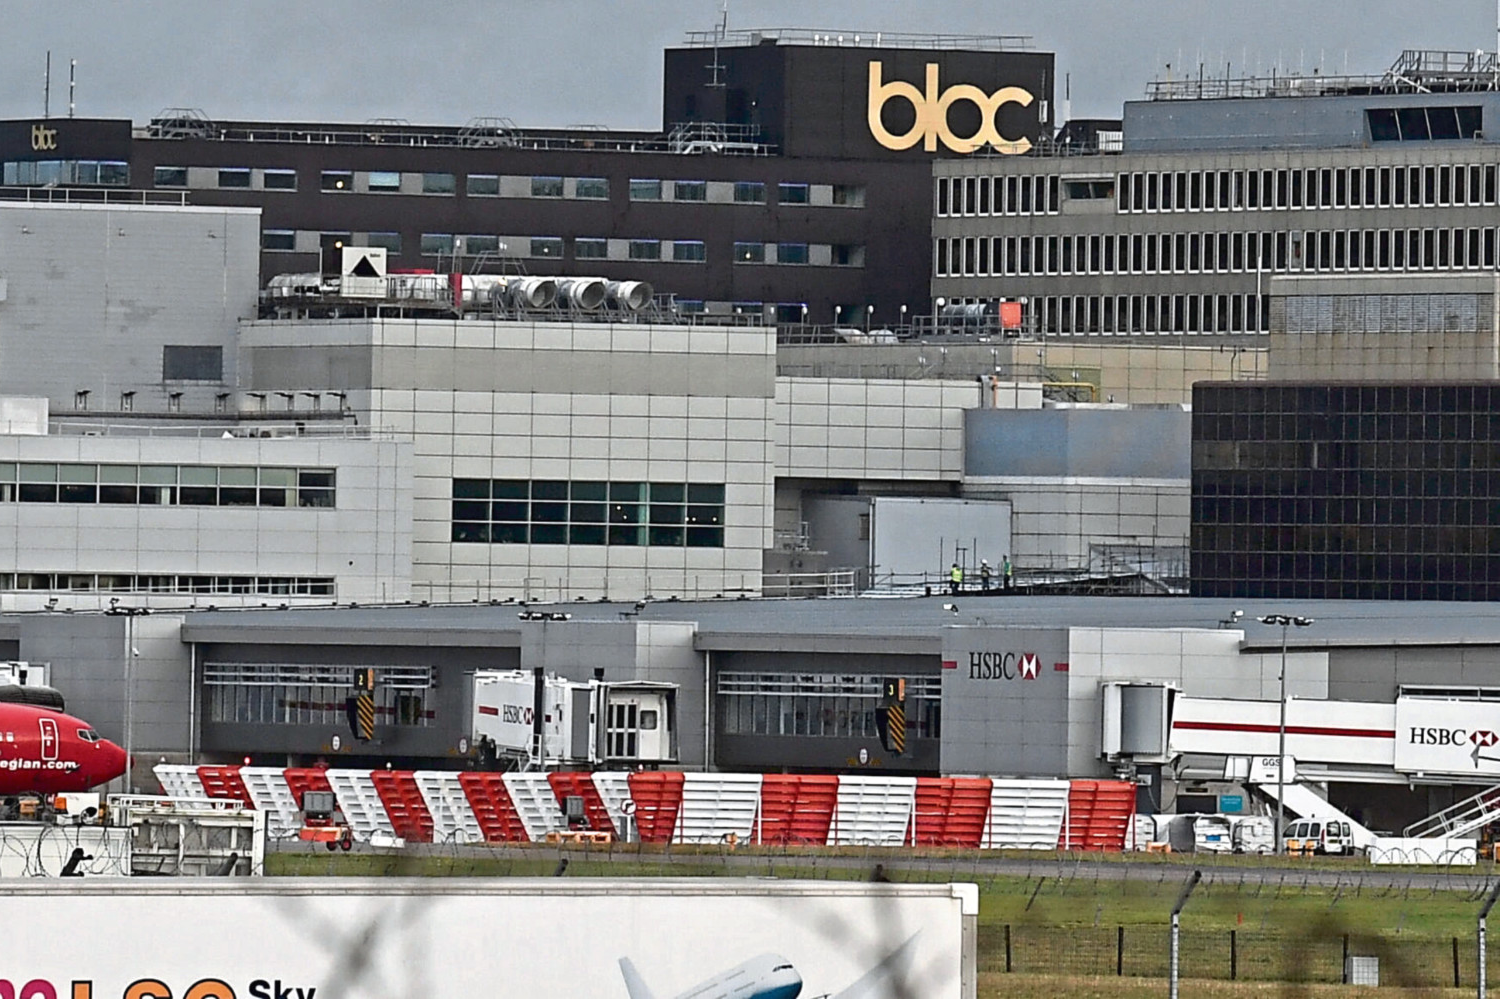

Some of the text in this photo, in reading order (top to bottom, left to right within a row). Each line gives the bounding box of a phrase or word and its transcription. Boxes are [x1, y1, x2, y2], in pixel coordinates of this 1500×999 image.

[868, 61, 1034, 155] bloc
[32, 125, 57, 150] bloc
[969, 651, 1016, 680] HSBC
[358, 674, 364, 686] 2
[888, 684, 894, 696] 3
[1409, 727, 1467, 746] HSBC
